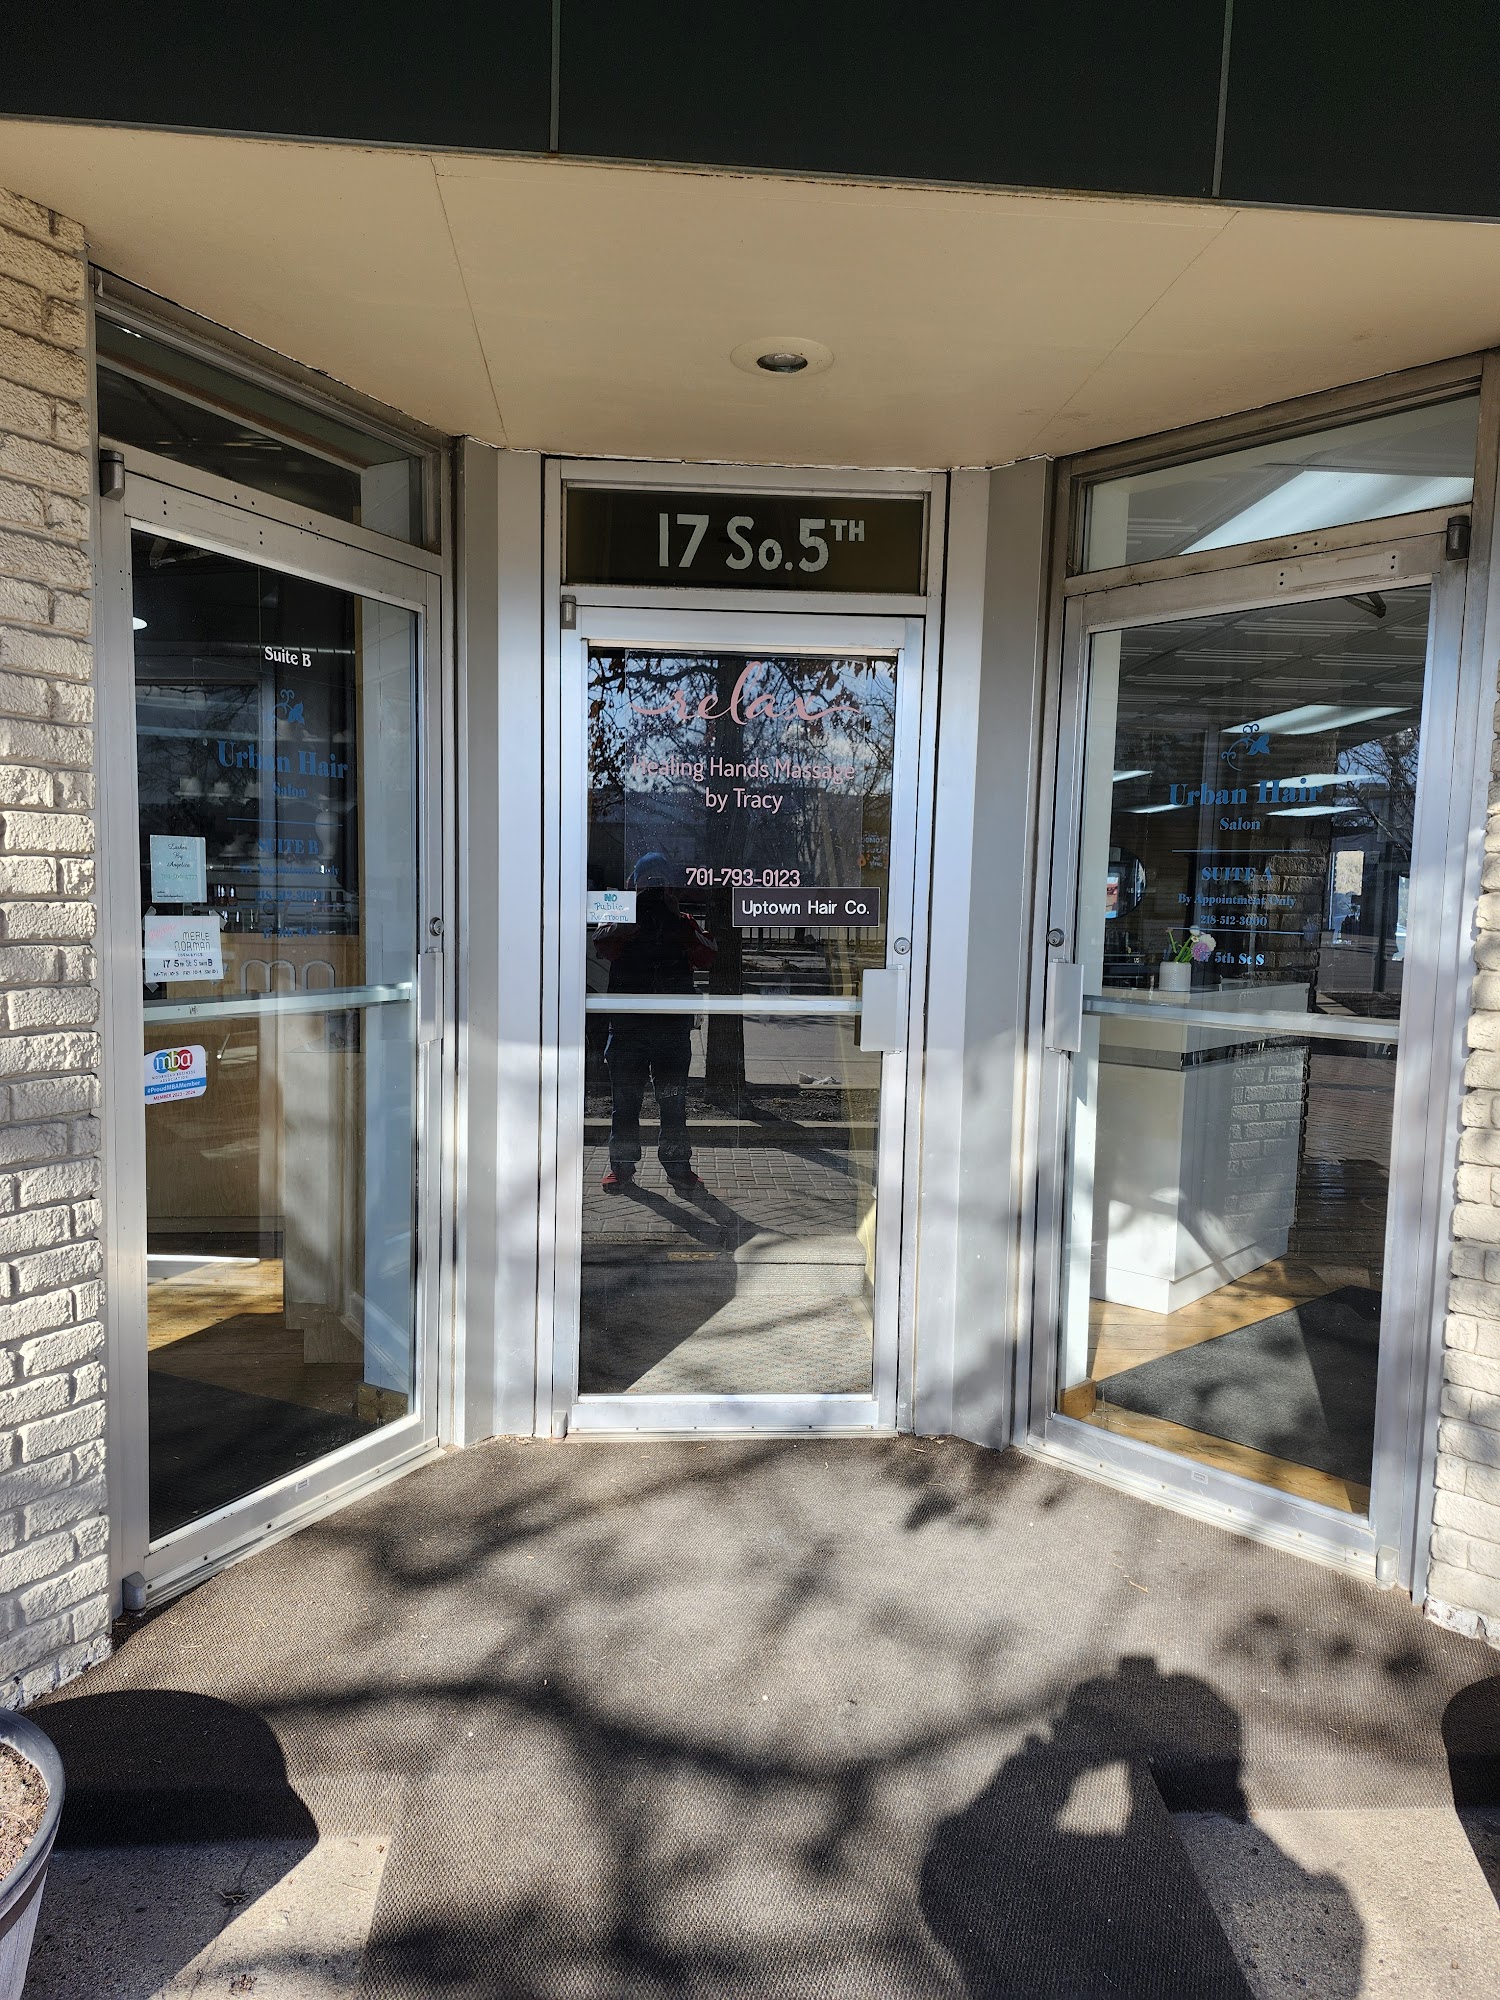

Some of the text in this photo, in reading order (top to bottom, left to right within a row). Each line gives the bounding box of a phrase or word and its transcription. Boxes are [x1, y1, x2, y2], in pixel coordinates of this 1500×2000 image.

[658, 513, 709, 568] 17
[265, 646, 311, 667] Suite B
[629, 661, 862, 725] relax
[217, 740, 348, 779] Urban Hair
[632, 755, 856, 785] Healing Hands Massage
[272, 782, 308, 798] Salon
[1168, 777, 1323, 806] Urban Hair
[705, 787, 783, 814] by Tracy
[1219, 817, 1261, 831] Salon
[257, 838, 319, 855] SUITE B
[685, 867, 801, 887] 701-793-0123
[1201, 866, 1274, 882] SUITE A
[604, 893, 618, 902] NO
[1178, 892, 1297, 908] By Appointment Only
[741, 900, 871, 917] Uptown Hair Co.
[1201, 914, 1268, 926] 218-512-3000
[183, 931, 210, 941] MERLE
[174, 940, 211, 951] NORMAN
[207, 958, 213, 966] B
[1215, 952, 1235, 964] 5th
[1238, 953, 1252, 965] St
[1255, 954, 1265, 966] S
[155, 1051, 192, 1071] mba
